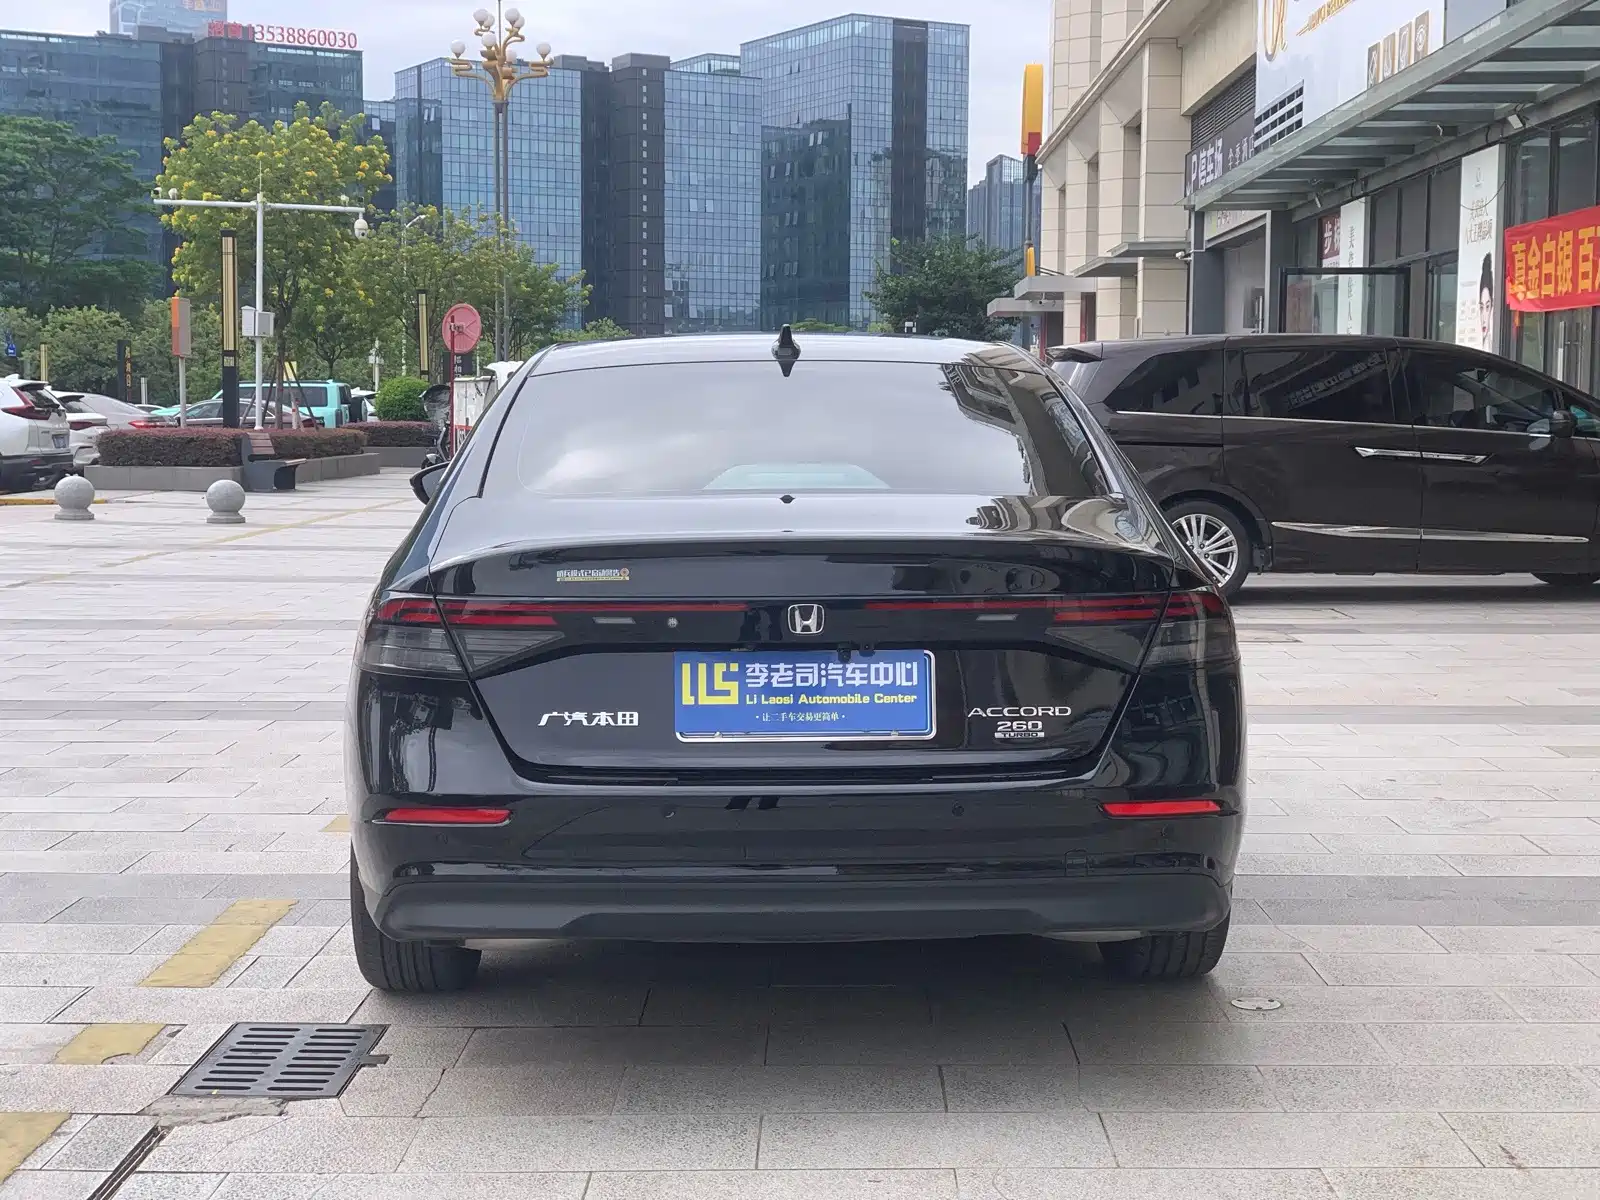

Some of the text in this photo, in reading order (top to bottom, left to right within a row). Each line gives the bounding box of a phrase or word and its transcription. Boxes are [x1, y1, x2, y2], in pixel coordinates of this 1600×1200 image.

[745, 661, 918, 688] 李老司汽车中心
[746, 692, 918, 705] Li Laosi Automobile Center
[967, 706, 1072, 718] ACCORD
[537, 711, 639, 727] 广汽本田
[996, 720, 1043, 732] 260
